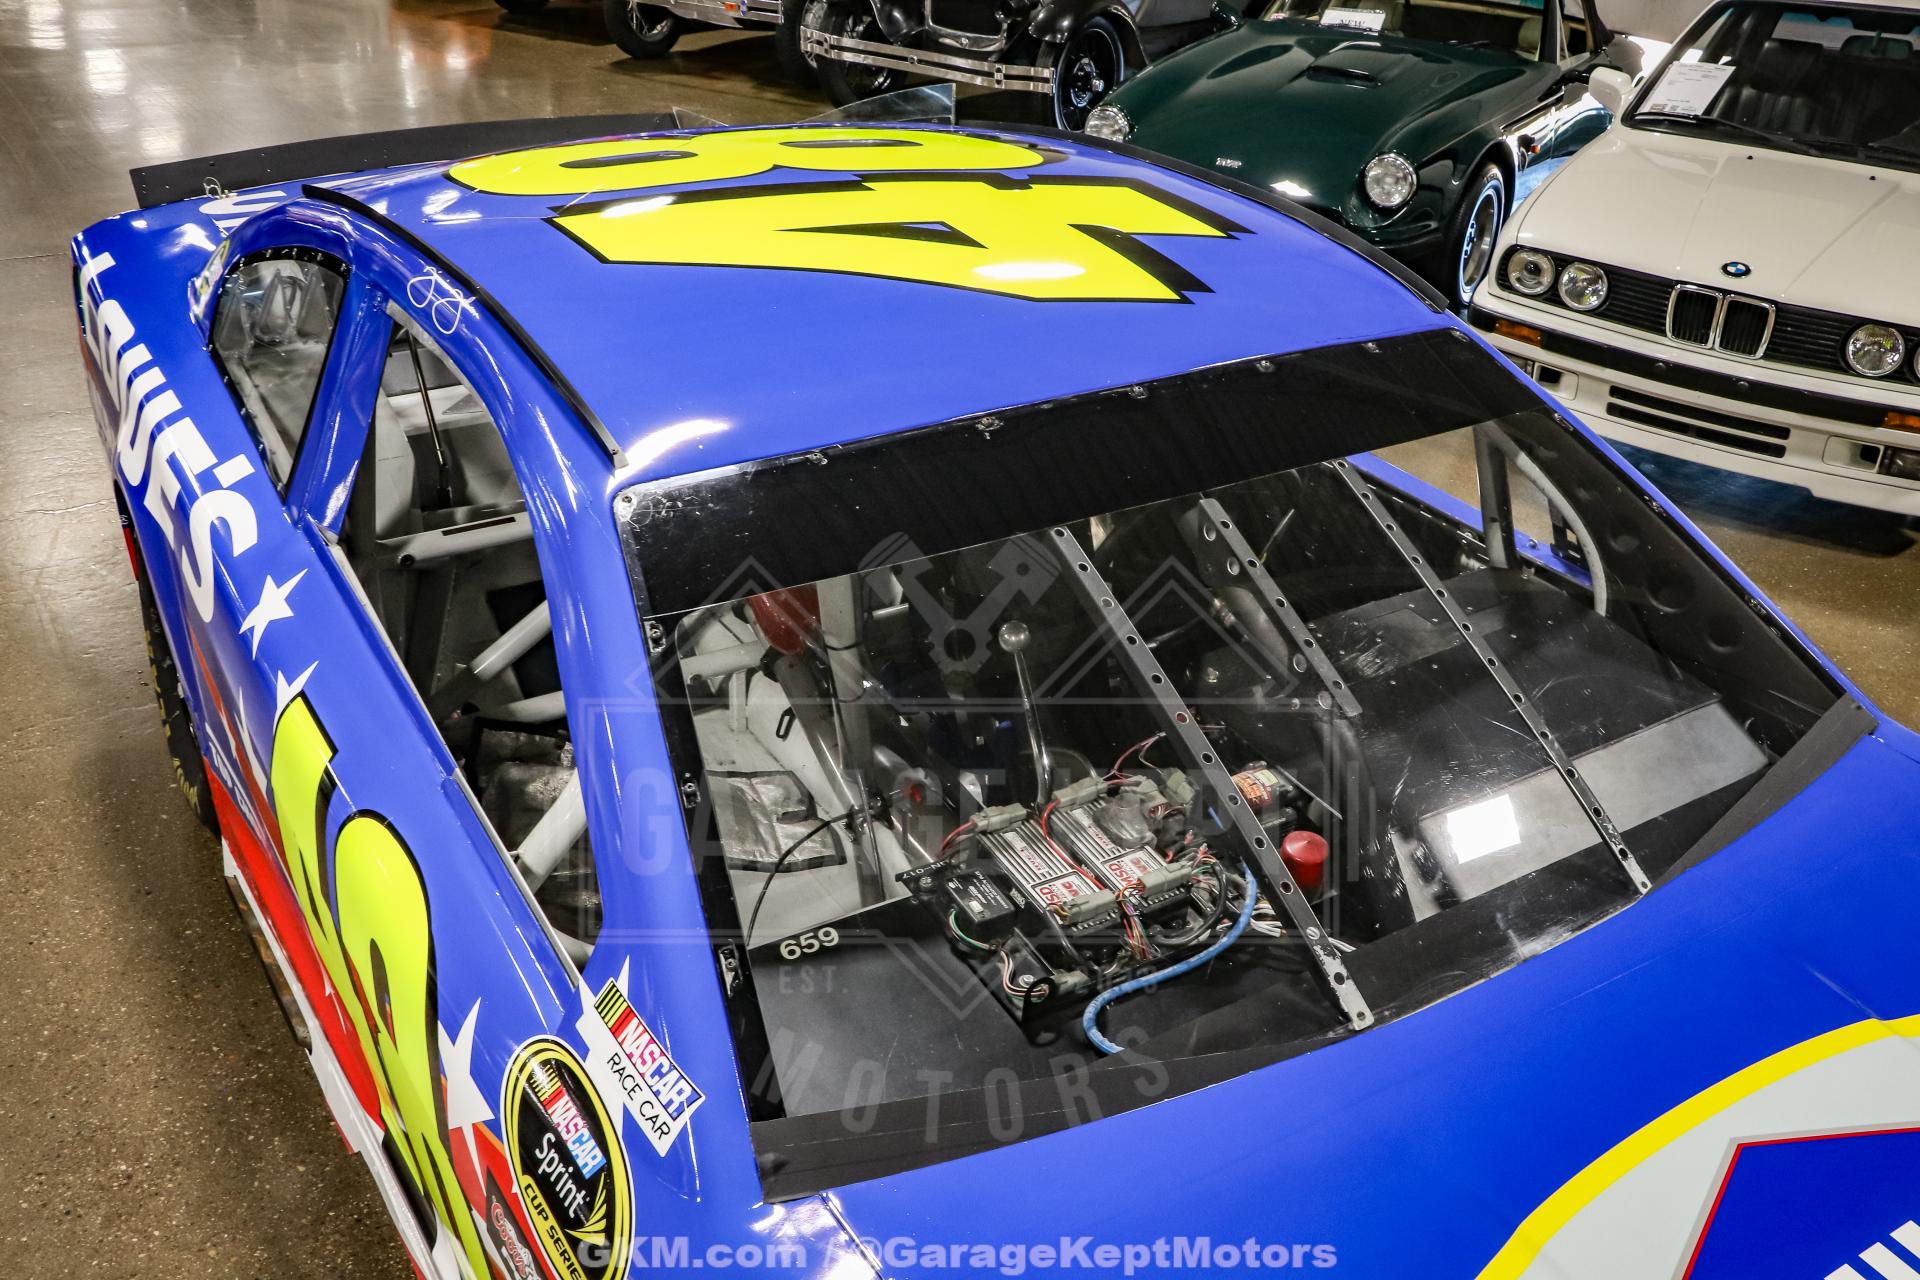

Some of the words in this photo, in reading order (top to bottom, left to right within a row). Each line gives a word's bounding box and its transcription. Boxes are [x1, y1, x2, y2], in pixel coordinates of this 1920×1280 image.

[446, 126, 1245, 303] 48
[780, 927, 839, 960] 659
[606, 1052, 643, 1101] RACE
[639, 1100, 671, 1141] CAR
[617, 1016, 693, 1115] NASCAR
[534, 1132, 584, 1219] Sprint
[548, 1093, 604, 1173] NASCAR
[524, 1183, 549, 1222] CUP
